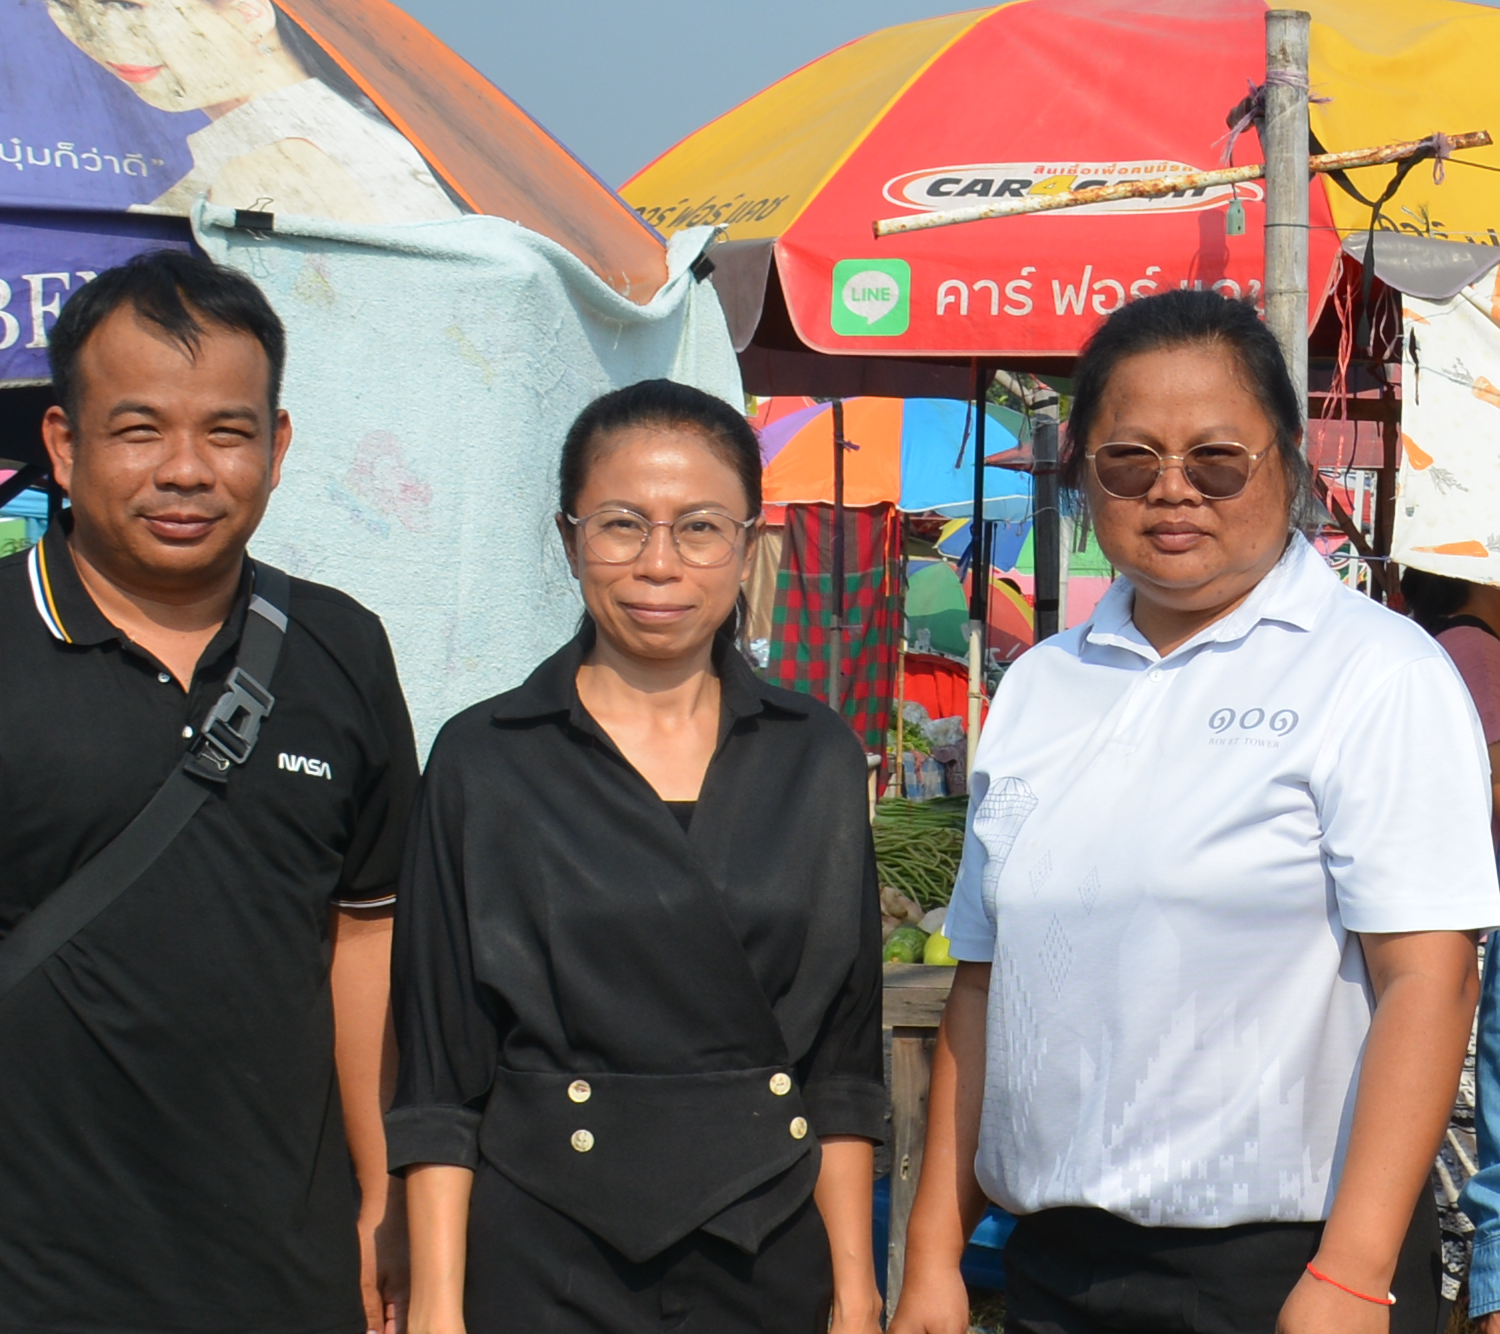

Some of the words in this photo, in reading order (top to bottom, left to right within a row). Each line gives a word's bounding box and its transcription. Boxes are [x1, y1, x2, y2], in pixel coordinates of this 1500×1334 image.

[851, 287, 890, 301] LINE
[1245, 738, 1279, 749] TOWER
[278, 753, 332, 780] NASA
